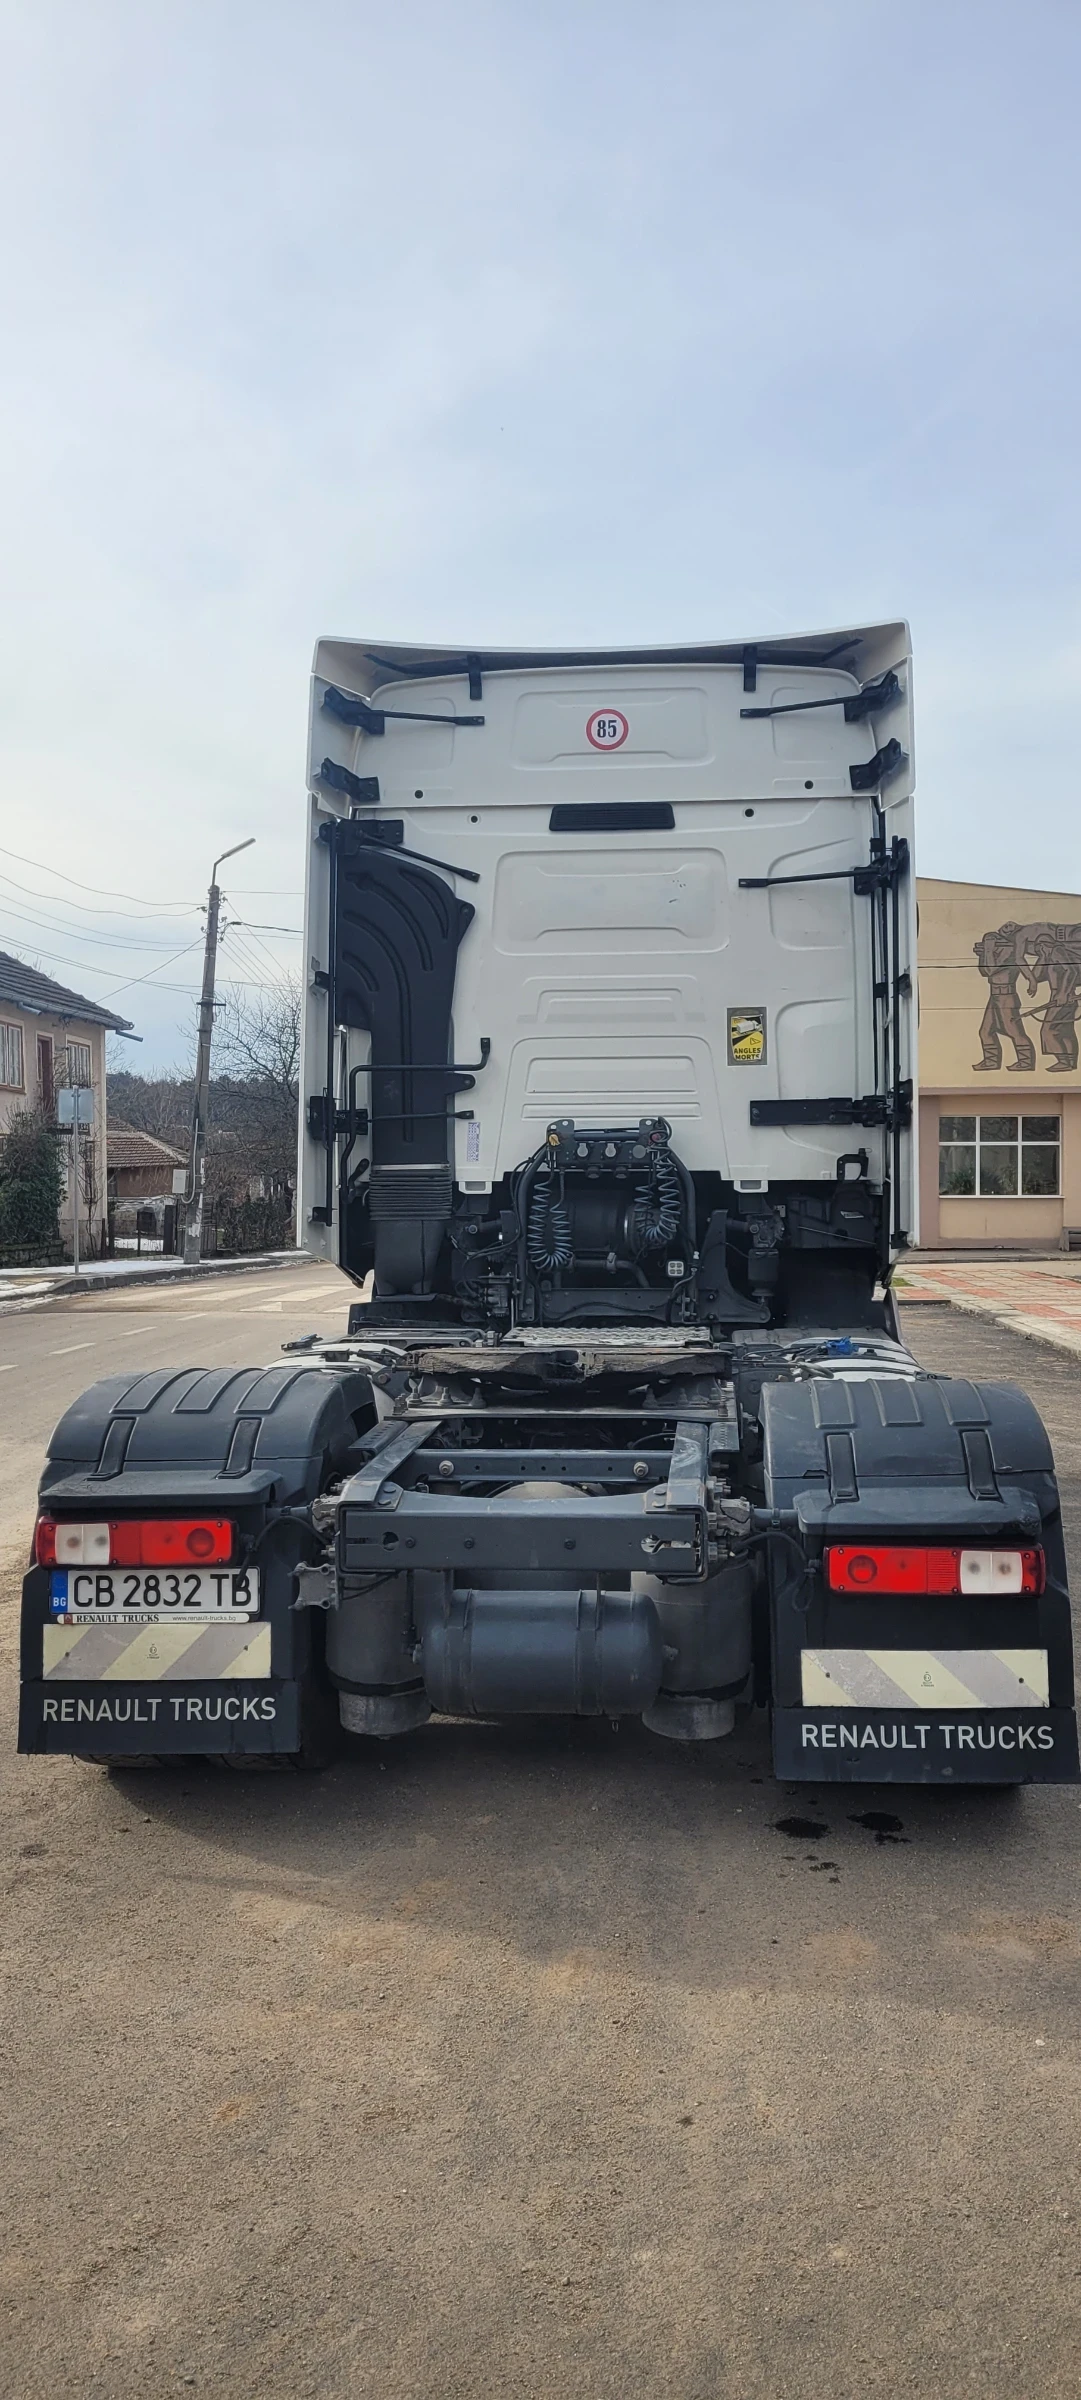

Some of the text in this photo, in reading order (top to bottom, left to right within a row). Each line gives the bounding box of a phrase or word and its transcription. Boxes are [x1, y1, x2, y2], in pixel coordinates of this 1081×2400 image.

[597, 719, 617, 738] 85
[53, 1597, 67, 1607] BG
[73, 1574, 252, 1608] CB 2832 TB
[76, 1614, 118, 1623] RENAULT
[122, 1614, 160, 1622] TRUCKS
[42, 1697, 277, 1722] RENAULT TRUCKS
[801, 1724, 1055, 1750] RENAULT TRUCKS
